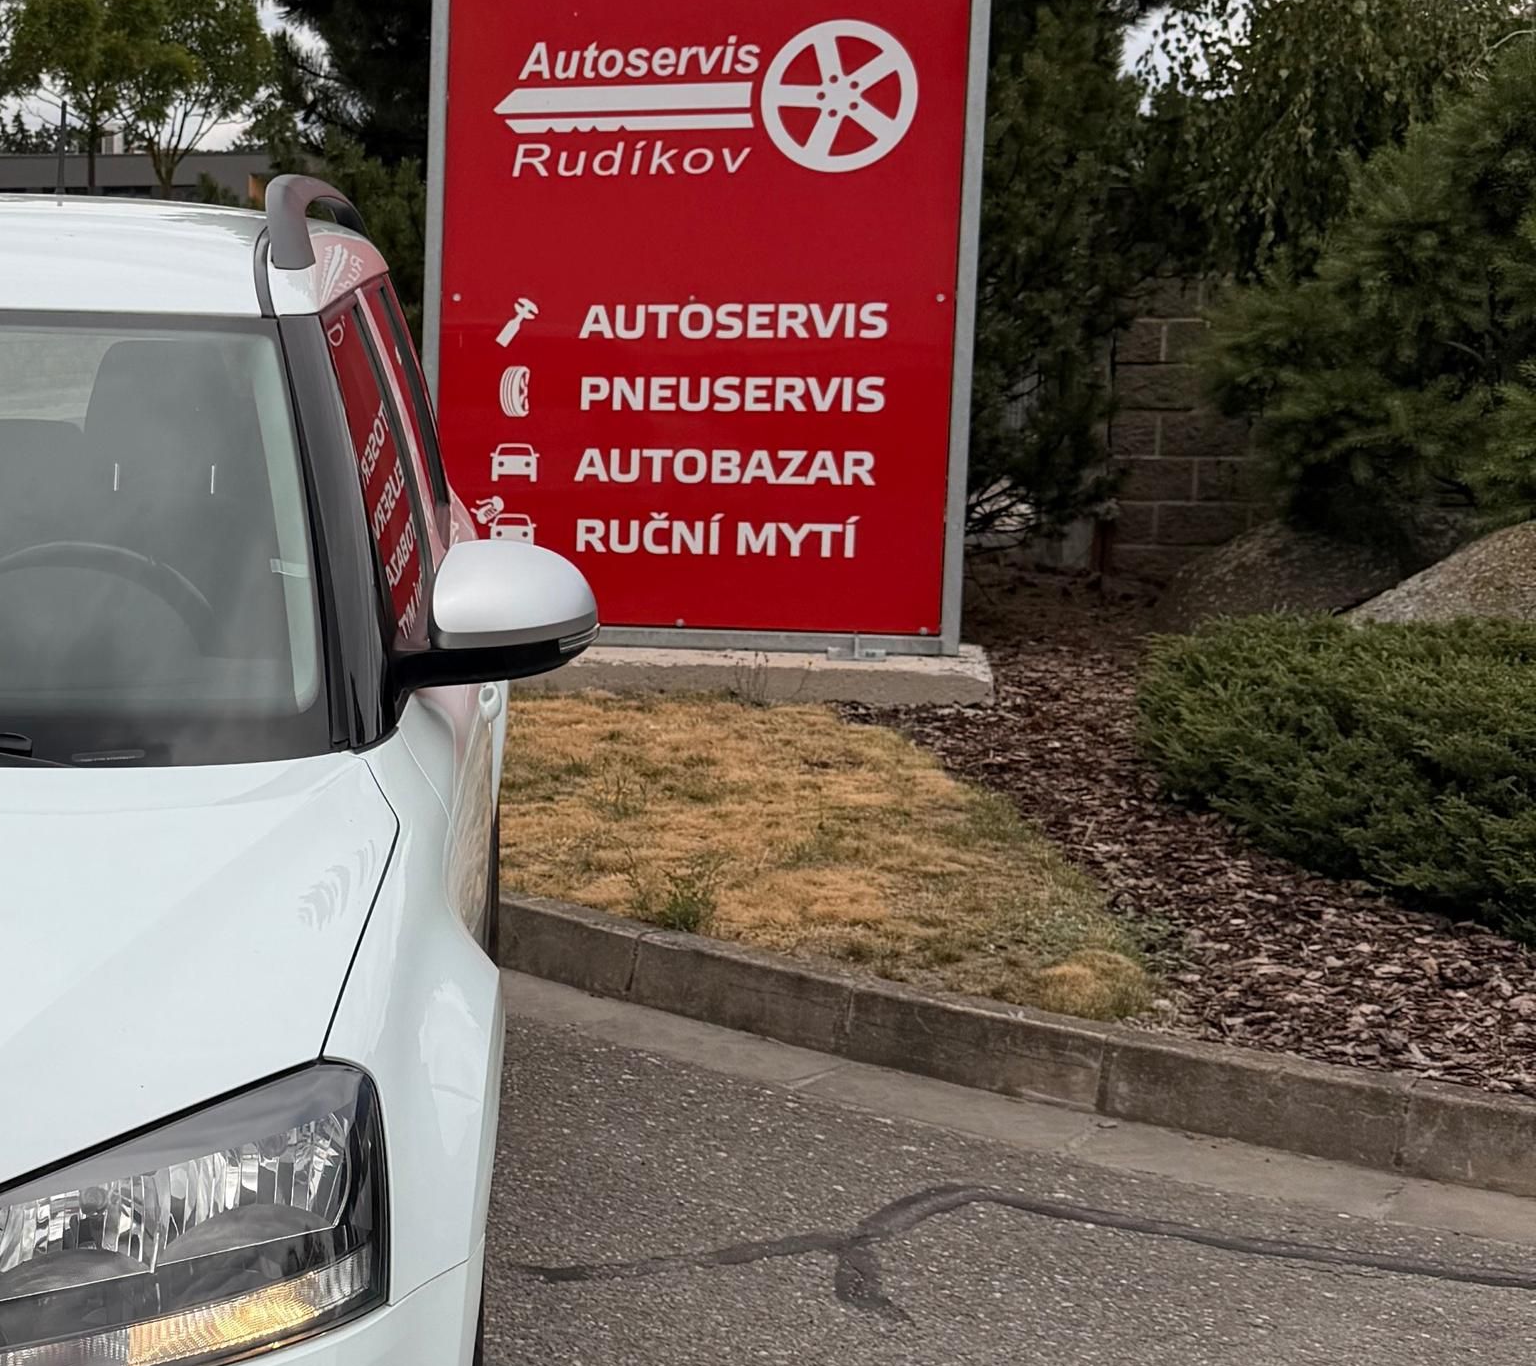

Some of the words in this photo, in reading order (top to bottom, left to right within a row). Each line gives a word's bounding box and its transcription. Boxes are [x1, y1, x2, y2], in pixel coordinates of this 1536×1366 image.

[518, 35, 761, 80] Autoservis
[511, 140, 751, 178] Rudíkov
[578, 302, 889, 340] AUTOSERVIS
[579, 376, 886, 413] PNEUSERVIS
[574, 448, 876, 486] AUTOBAZAR
[576, 512, 721, 555] RUČNÍ
[735, 515, 861, 558] MYTÍ
